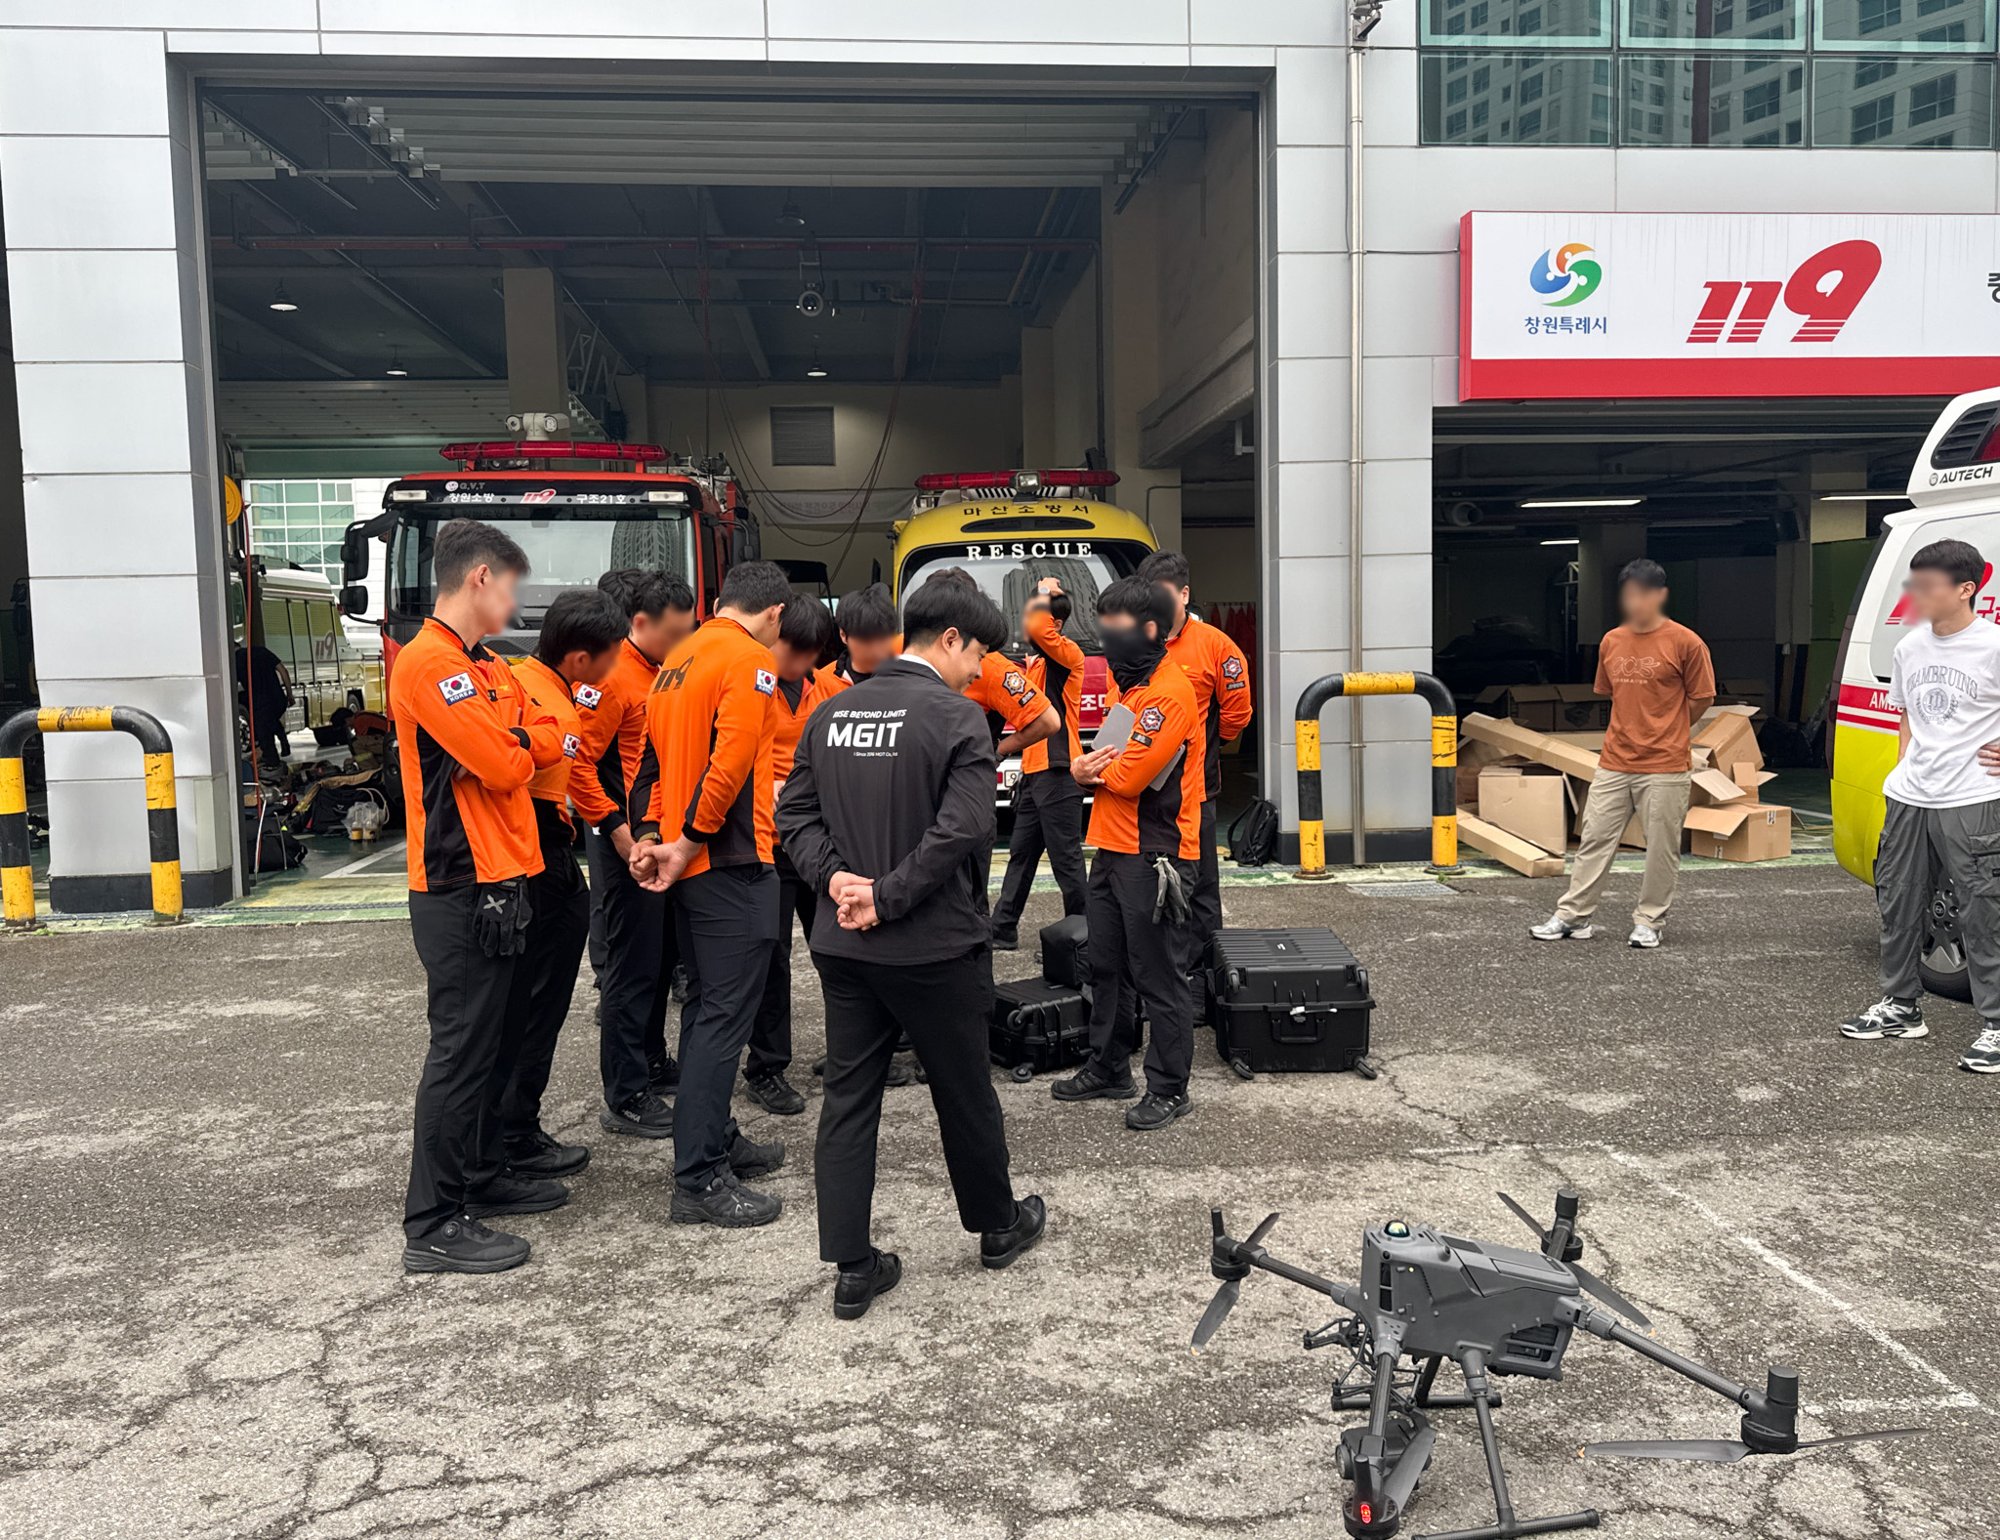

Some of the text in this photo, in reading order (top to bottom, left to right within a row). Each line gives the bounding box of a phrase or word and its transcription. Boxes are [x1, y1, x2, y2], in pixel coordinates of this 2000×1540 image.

[1685, 239, 1882, 343] 119
[1524, 315, 1607, 335] 창원특례시
[1938, 466, 1994, 484] AUTECH
[449, 492, 495, 503] 창원소방
[520, 488, 557, 504] 119
[576, 493, 627, 504] 구조21호
[963, 503, 1090, 517] 마산소방서
[966, 542, 1093, 561] RESCUE
[449, 690, 474, 703] KOREA
[849, 710, 883, 719] BEYOND
[882, 709, 907, 719] LIMITS
[827, 721, 904, 748] MGIT
